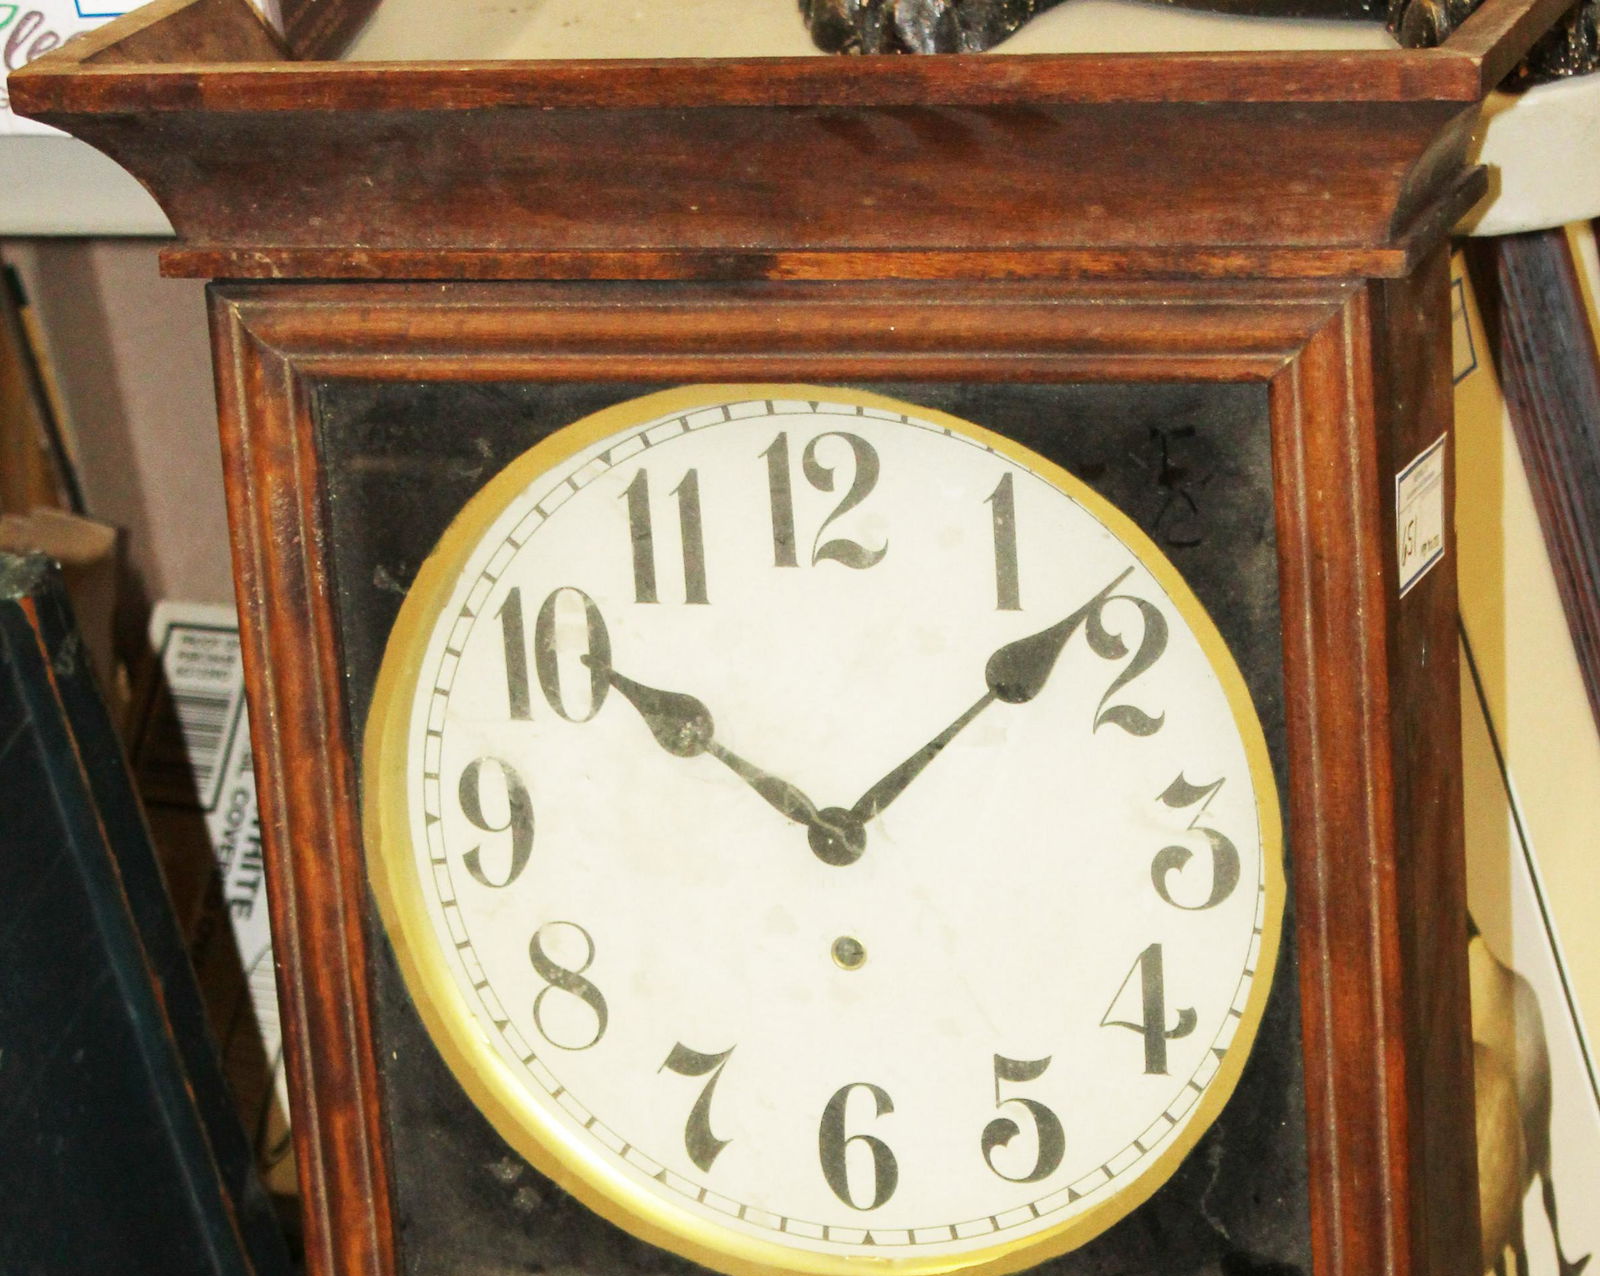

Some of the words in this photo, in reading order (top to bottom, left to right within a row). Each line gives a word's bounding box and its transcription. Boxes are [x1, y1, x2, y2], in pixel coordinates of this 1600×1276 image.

[618, 467, 711, 605] 11
[758, 430, 889, 569] 12
[983, 471, 1023, 612] 1
[495, 585, 612, 724] 10
[1085, 595, 1169, 737] 2
[457, 757, 535, 889] 9
[1150, 772, 1241, 911] 3
[528, 921, 610, 1052] 8
[1099, 943, 1198, 1076] 4
[656, 1042, 737, 1174] 7
[817, 1081, 900, 1213] 6
[980, 1053, 1066, 1184] 5
